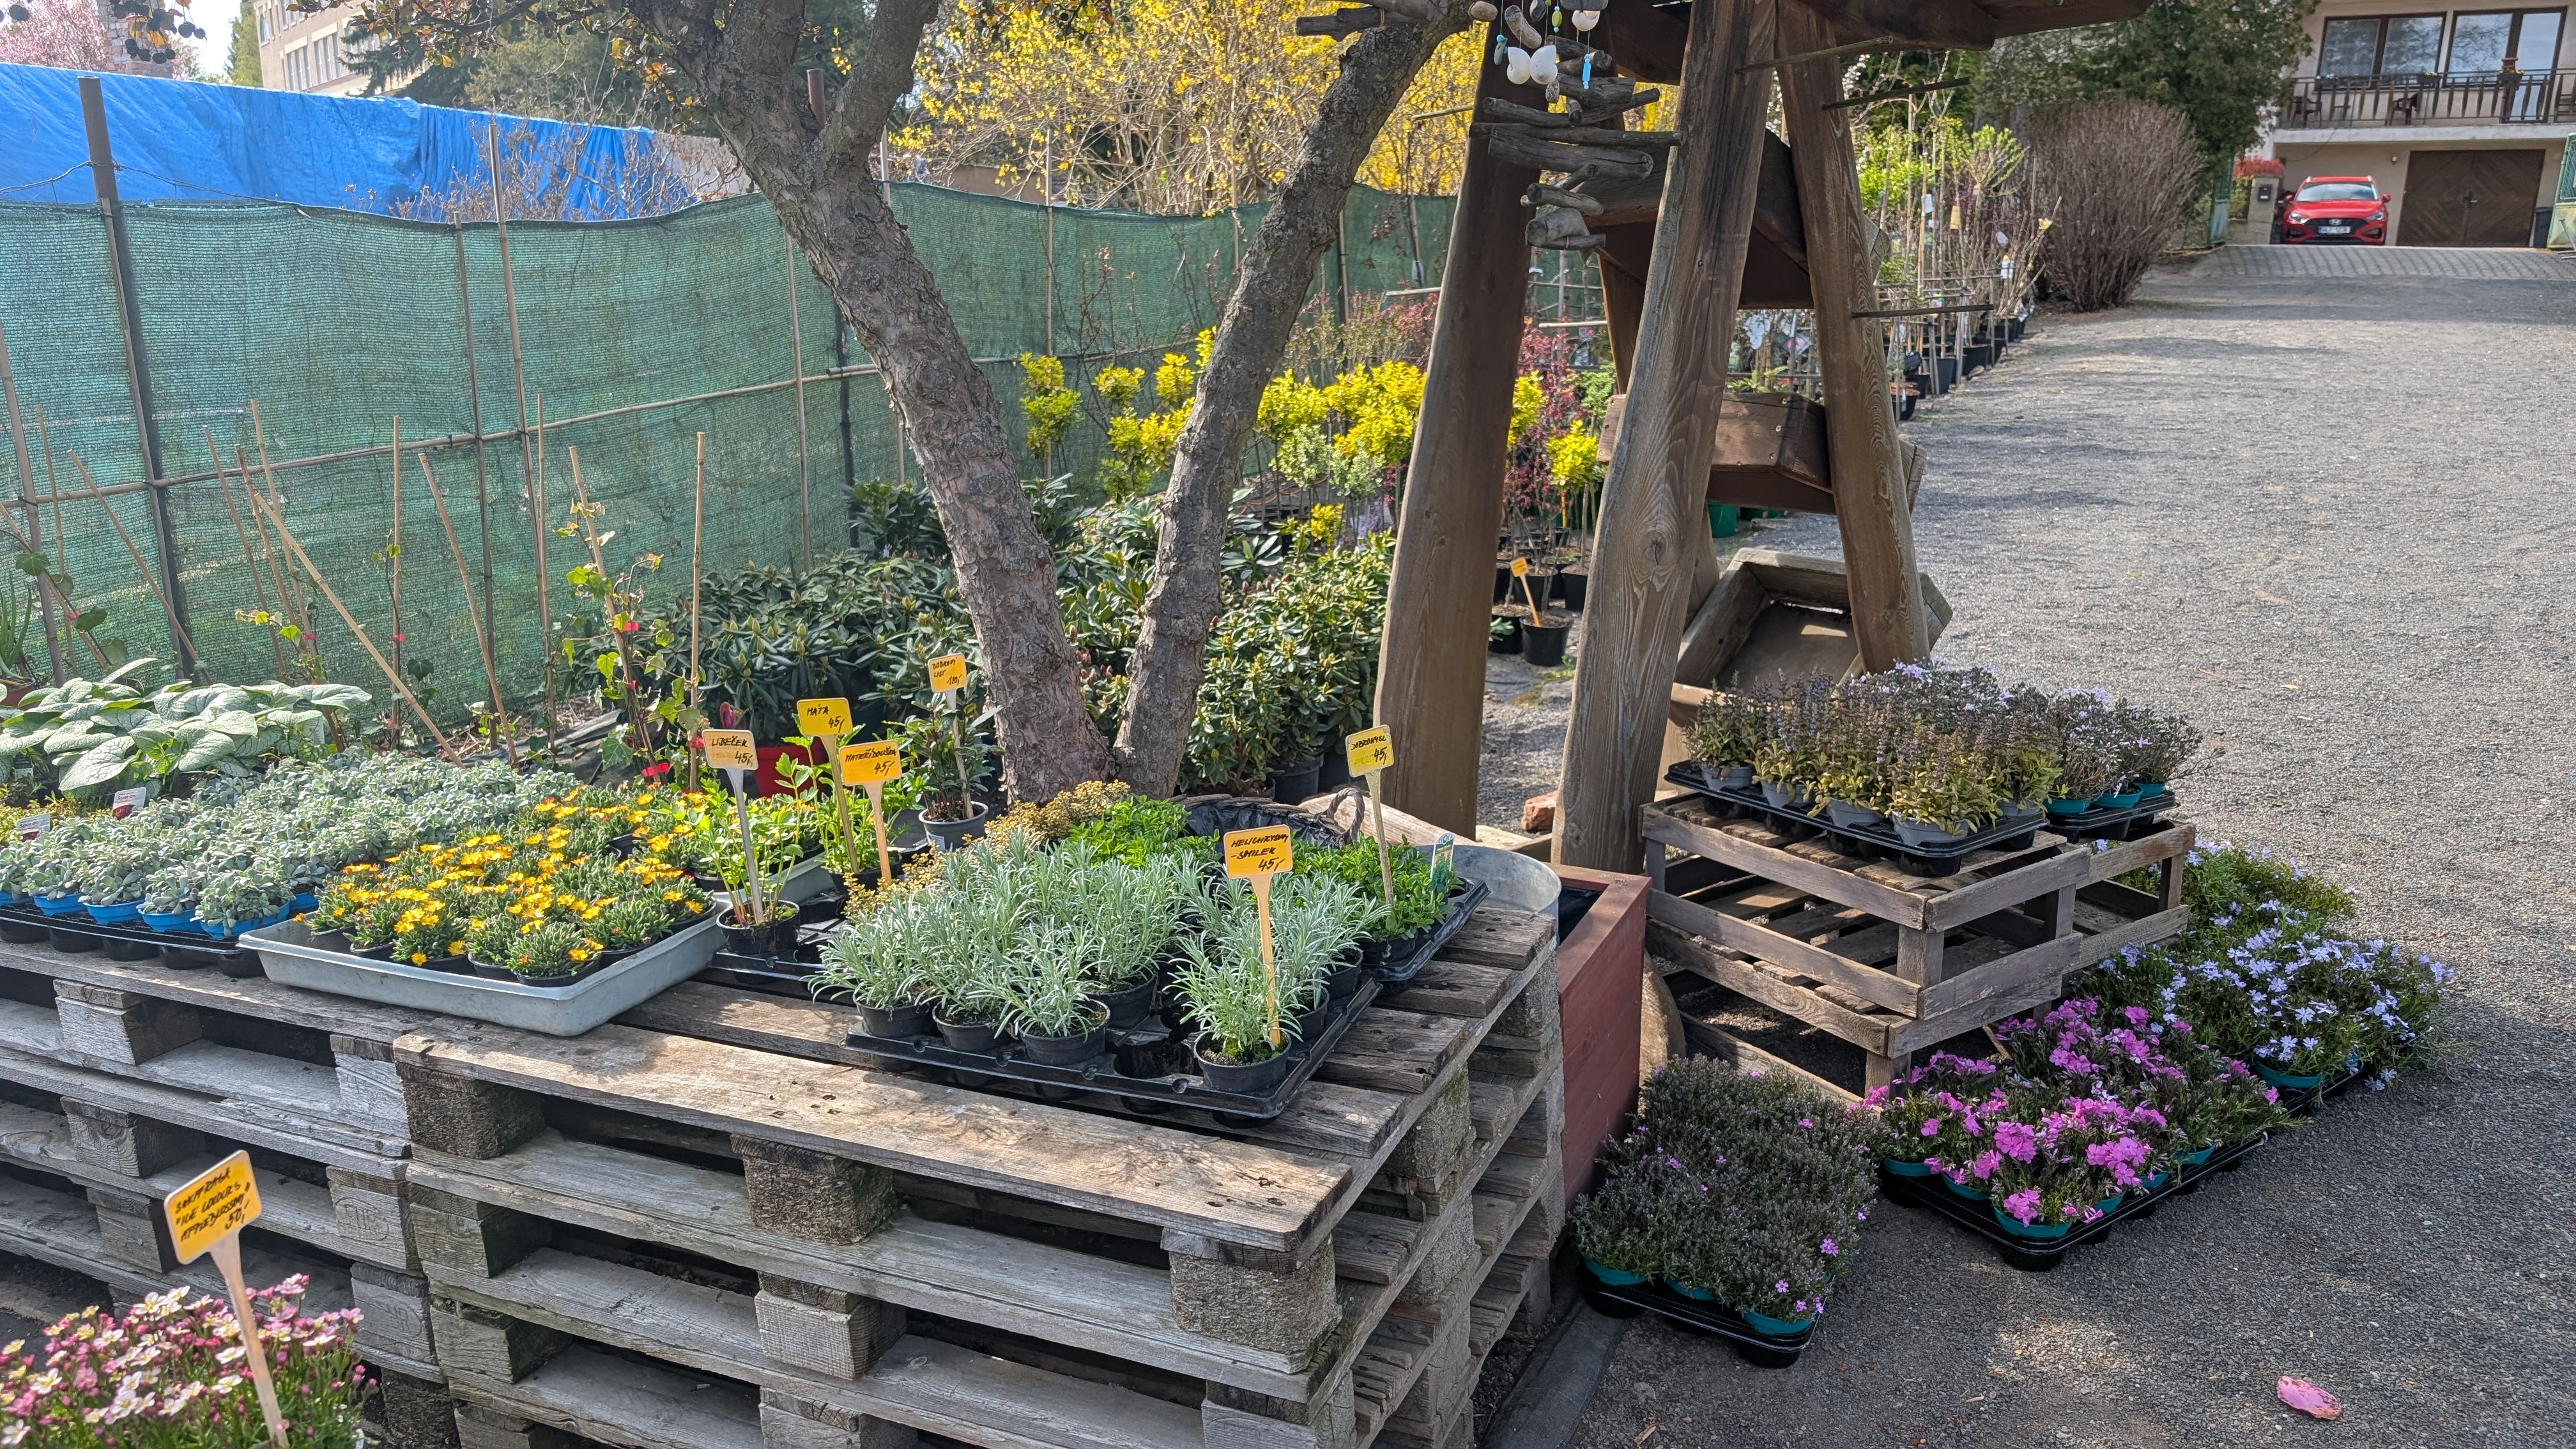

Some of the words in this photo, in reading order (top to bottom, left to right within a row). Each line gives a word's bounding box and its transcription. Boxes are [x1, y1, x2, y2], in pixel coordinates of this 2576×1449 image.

[934, 670, 946, 678] LIST
[807, 703, 829, 716] MÁTA
[711, 735, 747, 747] LIBEČEK
[1351, 735, 1386, 750] DOBROMYSL
